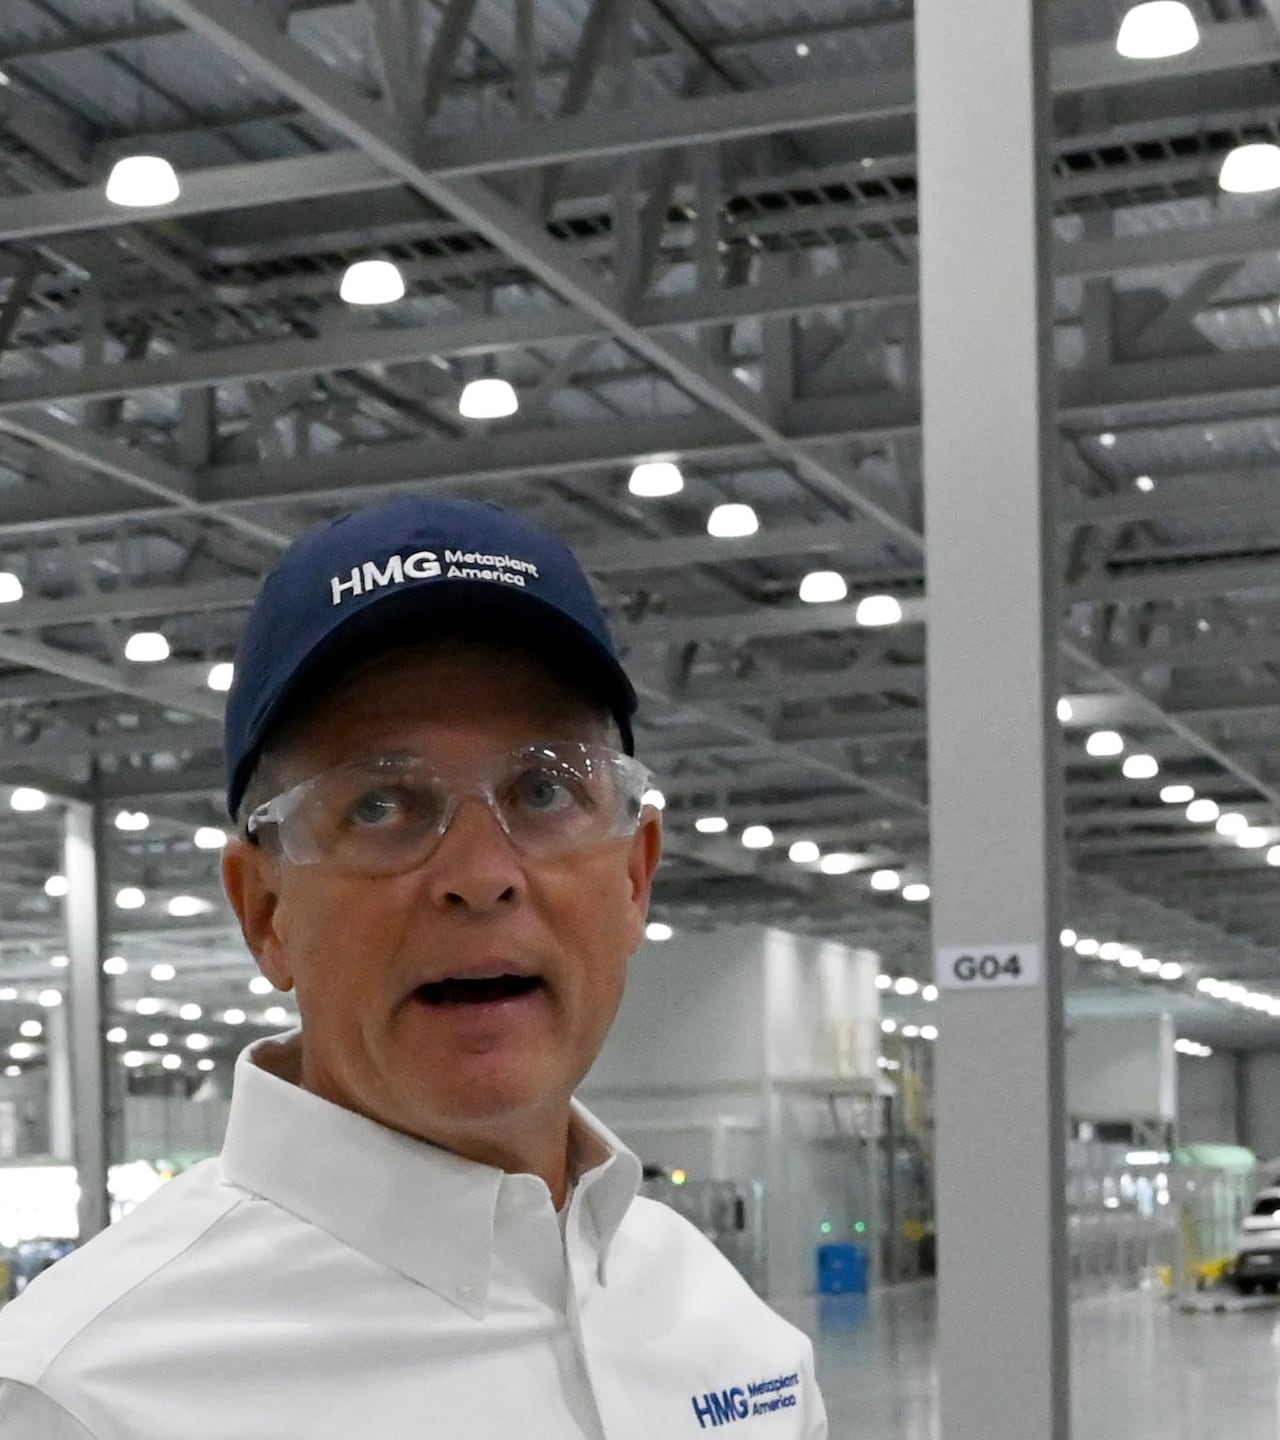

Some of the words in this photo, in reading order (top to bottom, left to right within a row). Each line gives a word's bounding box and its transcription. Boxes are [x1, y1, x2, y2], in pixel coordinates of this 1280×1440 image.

[444, 550, 539, 578] Metaplant
[446, 566, 525, 587] America
[331, 551, 441, 605] HMG
[953, 954, 1021, 981] G04
[747, 1373, 800, 1398] Metaplant
[691, 1387, 749, 1429] HMG
[752, 1393, 796, 1416] America
